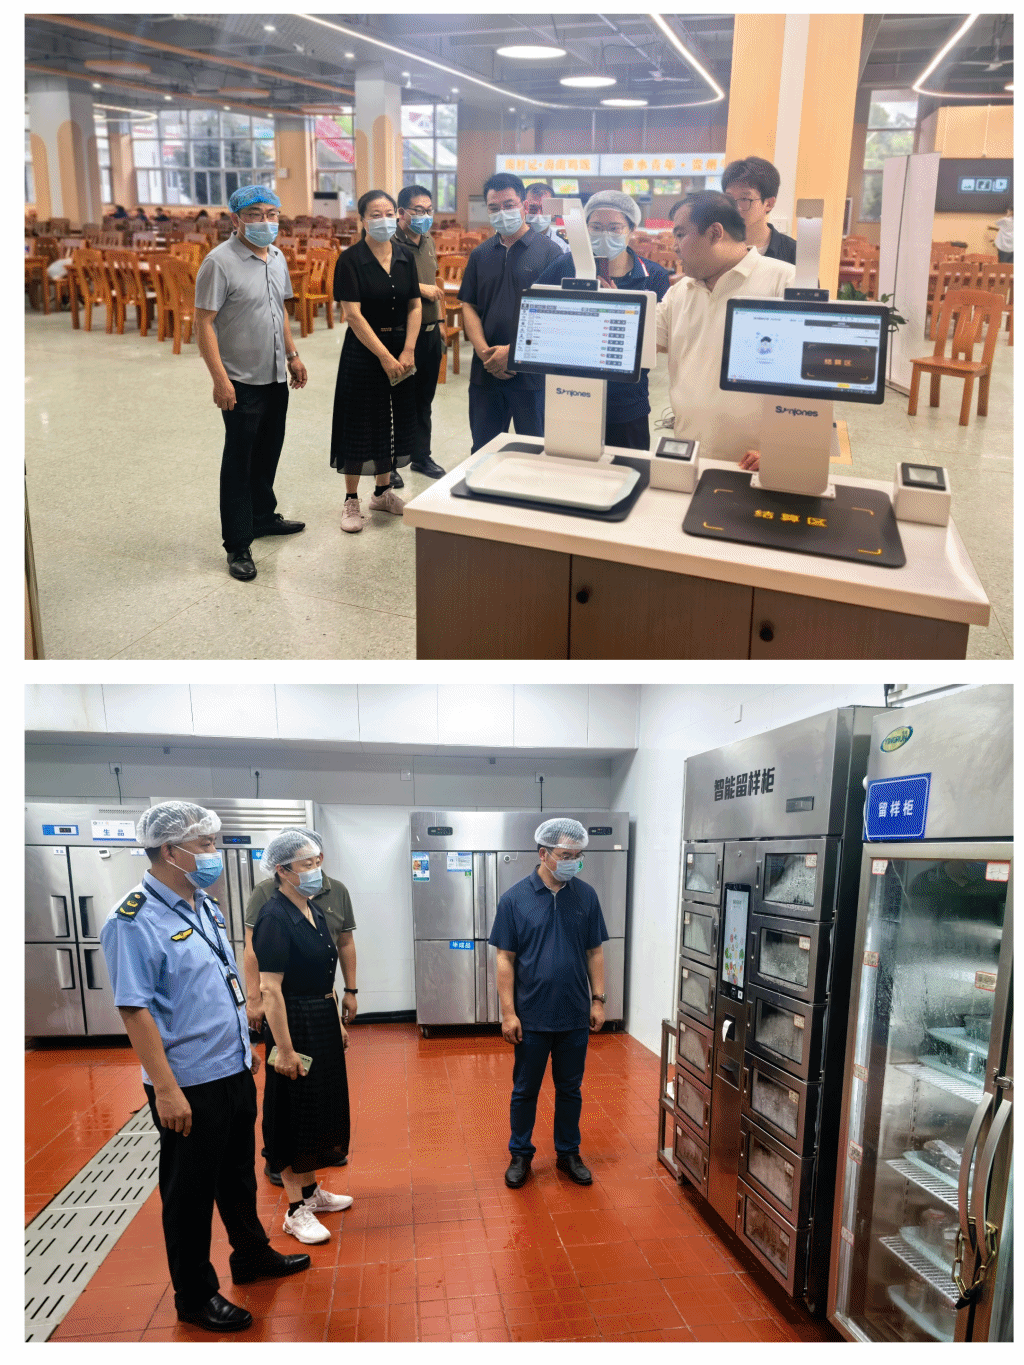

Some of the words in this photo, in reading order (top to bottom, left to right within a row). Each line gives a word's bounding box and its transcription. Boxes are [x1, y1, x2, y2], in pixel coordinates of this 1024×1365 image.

[714, 767, 775, 802] 智能留样柜
[878, 799, 913, 818] 留样柜
[103, 828, 125, 837] 生品
